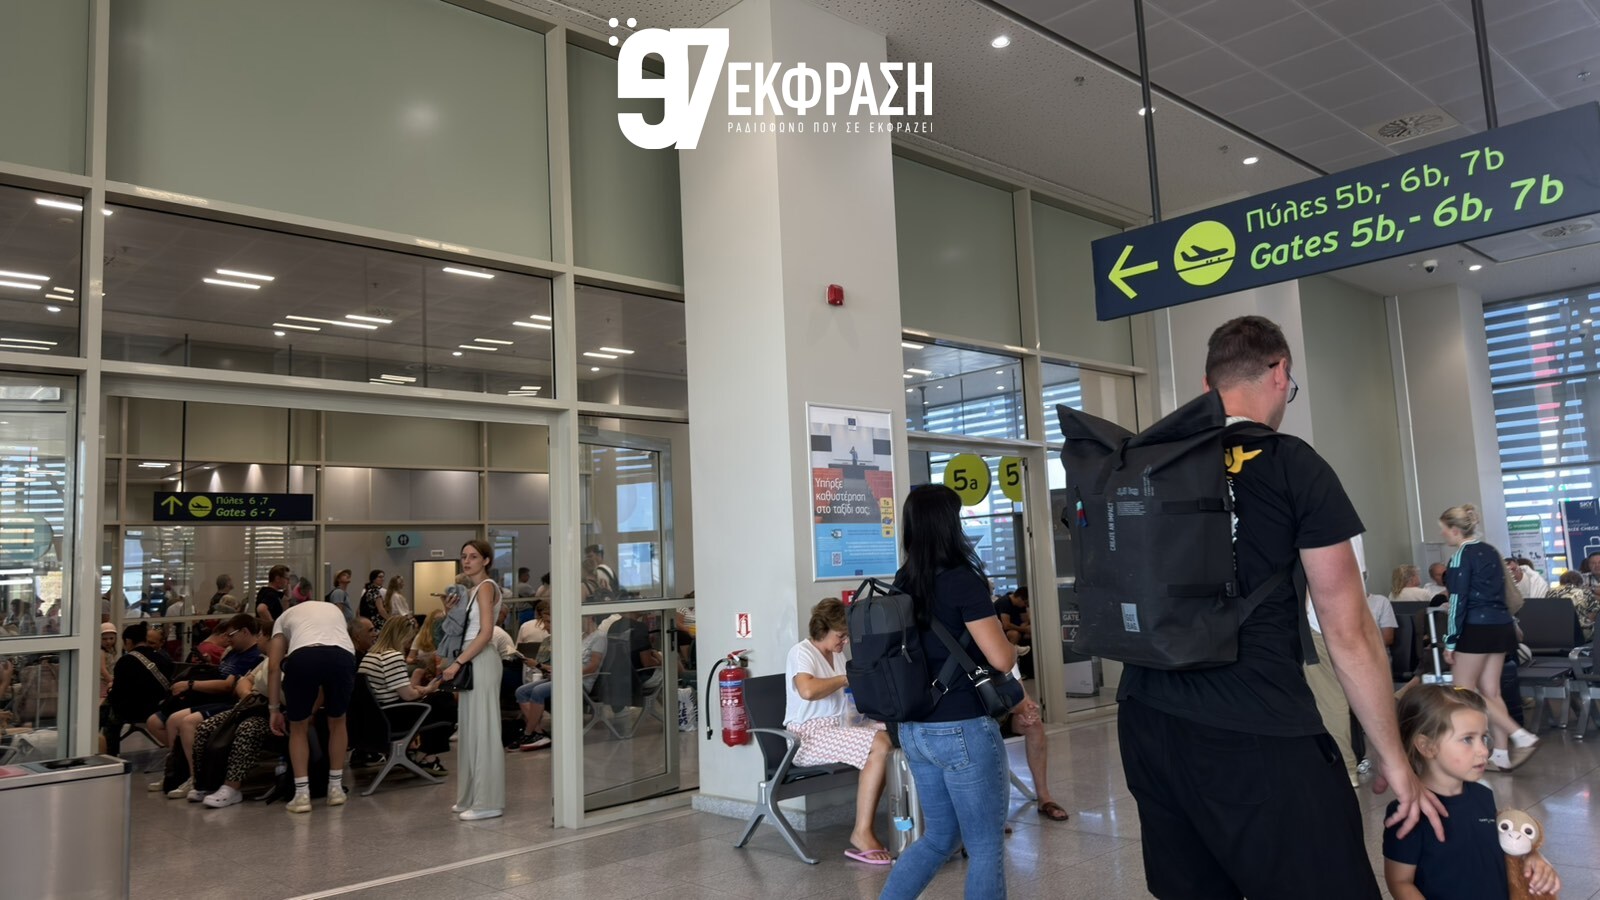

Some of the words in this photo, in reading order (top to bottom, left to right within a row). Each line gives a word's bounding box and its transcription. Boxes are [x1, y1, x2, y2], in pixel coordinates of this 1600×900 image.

[1246, 196, 1328, 232] Πύλες
[1401, 165, 1450, 193] 6b,
[1461, 147, 1505, 176] 7b
[1250, 231, 1339, 270] Gates
[1433, 192, 1493, 228] 6b,
[1510, 175, 1564, 211] 7b
[953, 468, 978, 491] 5a
[1006, 462, 1020, 487] 5
[815, 477, 843, 490] Υπήρξε
[215, 496, 244, 505] Πύλες
[249, 497, 256, 505] 6
[815, 490, 866, 502] καθυστέρηση
[215, 507, 246, 518] Gates
[250, 508, 258, 517] 6
[268, 508, 276, 517] 7
[816, 505, 831, 514] στο
[833, 503, 854, 516] ταξίδι
[1108, 522, 1115, 531] AN
[1109, 531, 1117, 551] CREATE
